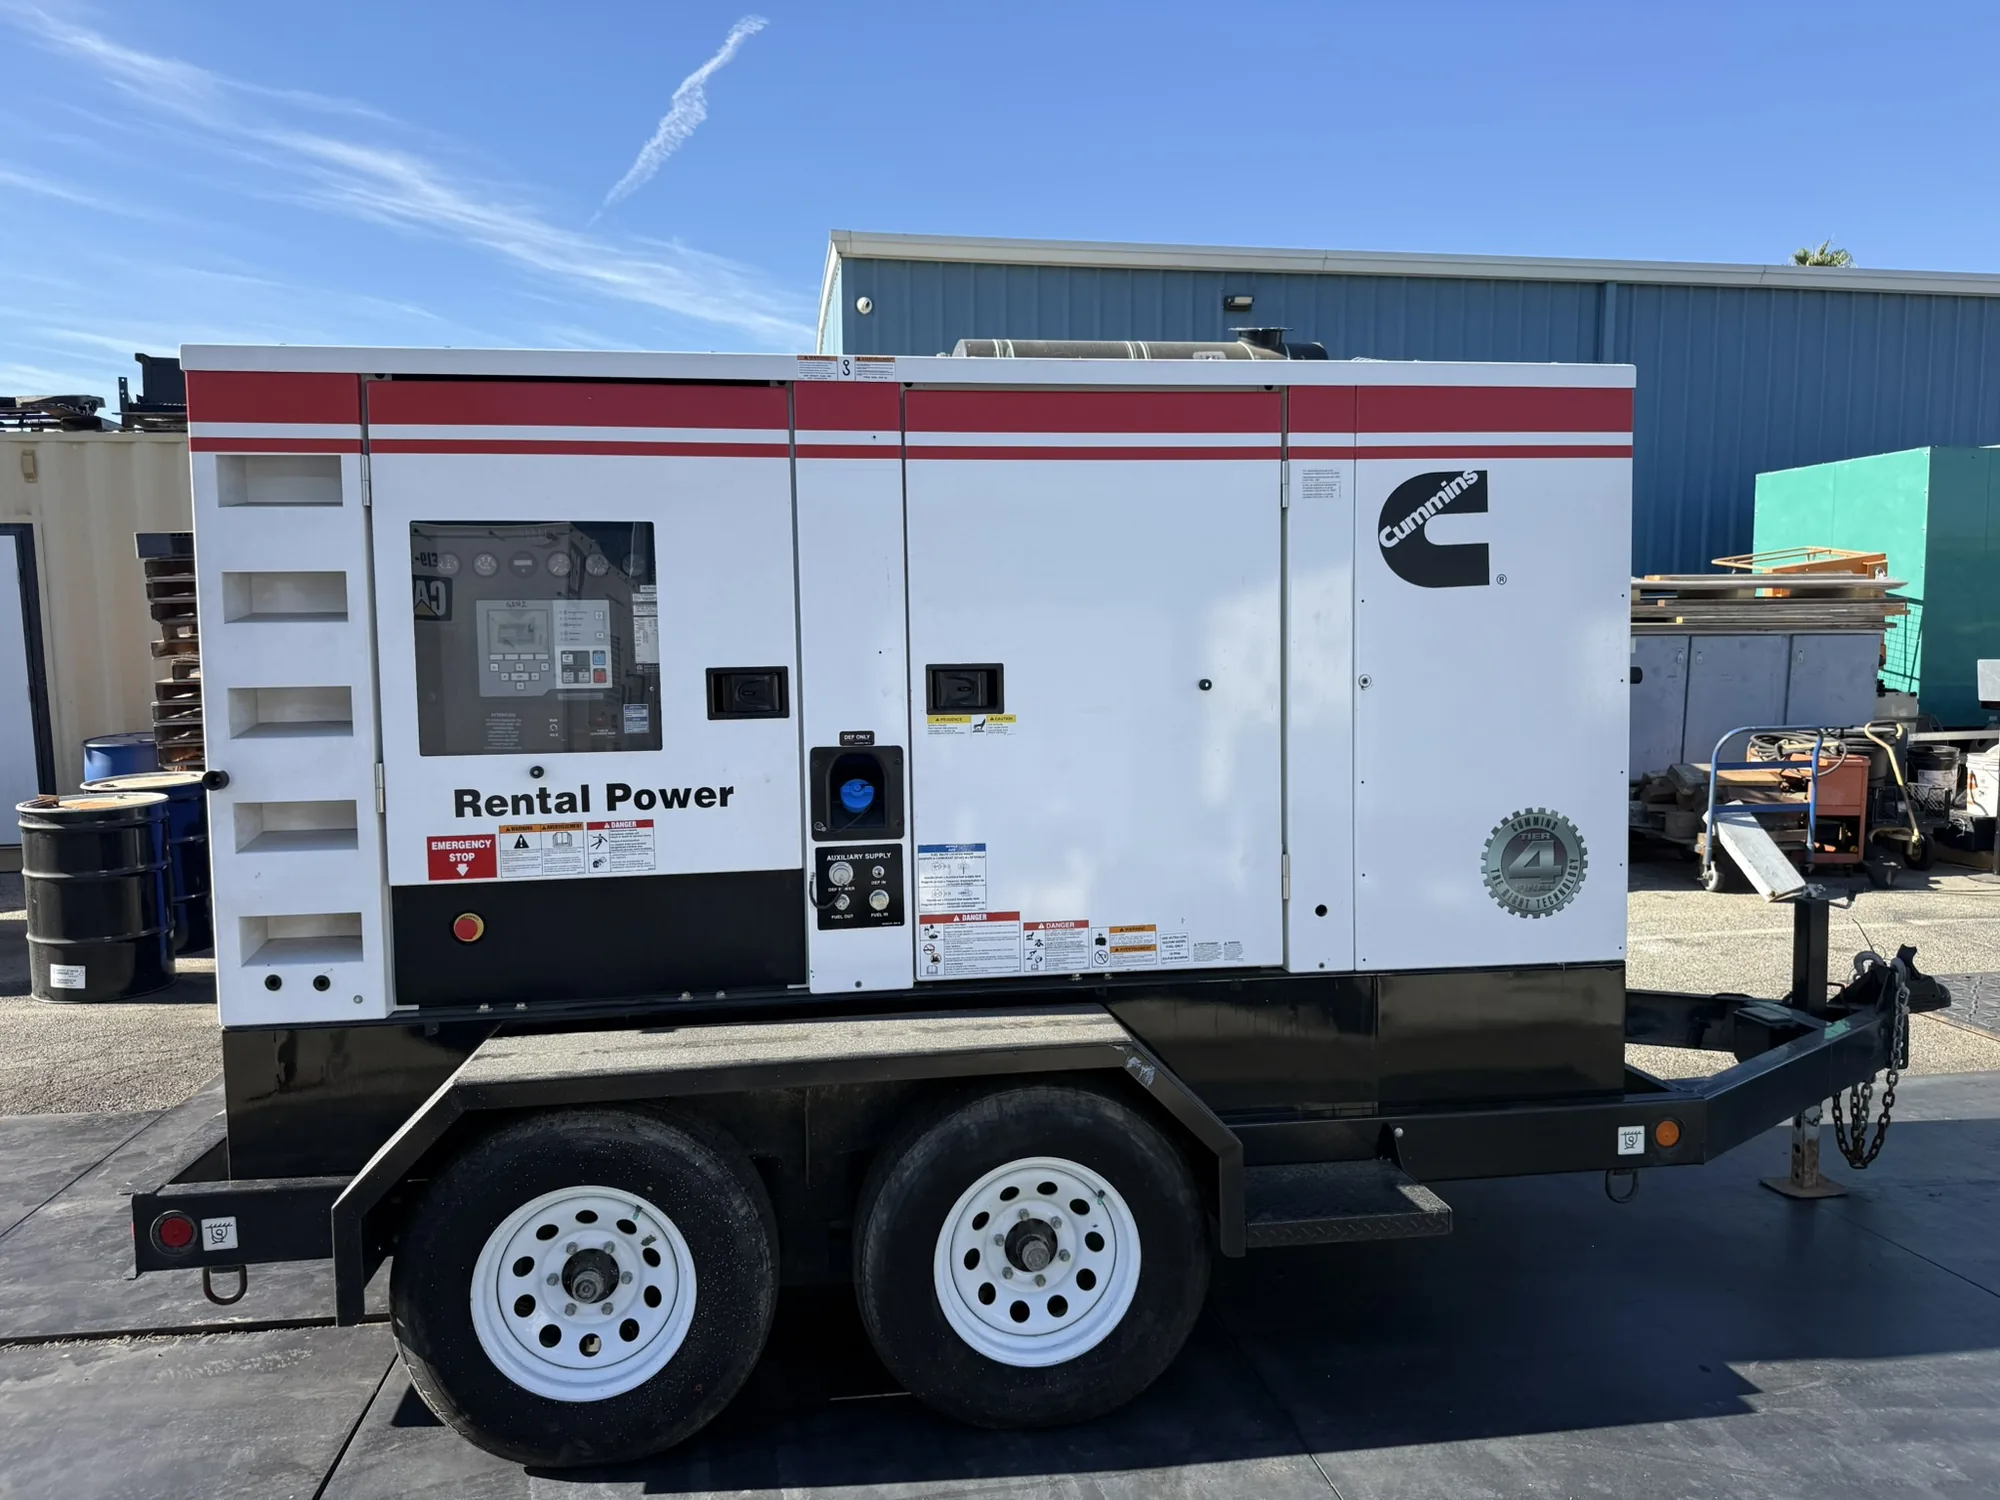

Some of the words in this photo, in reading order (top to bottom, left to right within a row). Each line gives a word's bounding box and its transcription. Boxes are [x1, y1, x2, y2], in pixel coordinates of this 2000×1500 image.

[1379, 469, 1479, 548] Cummins
[454, 784, 590, 818] Rental
[606, 782, 735, 812] Power
[610, 821, 637, 829] DANGER
[1510, 816, 1558, 833] CUMMINS
[1519, 832, 1551, 840] TIER
[431, 839, 491, 850] EMERGENCY
[449, 852, 475, 862] STOP
[827, 853, 863, 862] AUXILIARY
[864, 852, 892, 860] SUPPLY
[1509, 840, 1564, 884] 4
[1490, 867, 1504, 887] THE
[1502, 888, 1530, 908] RIGHT
[1536, 858, 1579, 909] TECHNOLOGY
[962, 913, 988, 921] DANGER
[1046, 921, 1075, 929] DANGER
